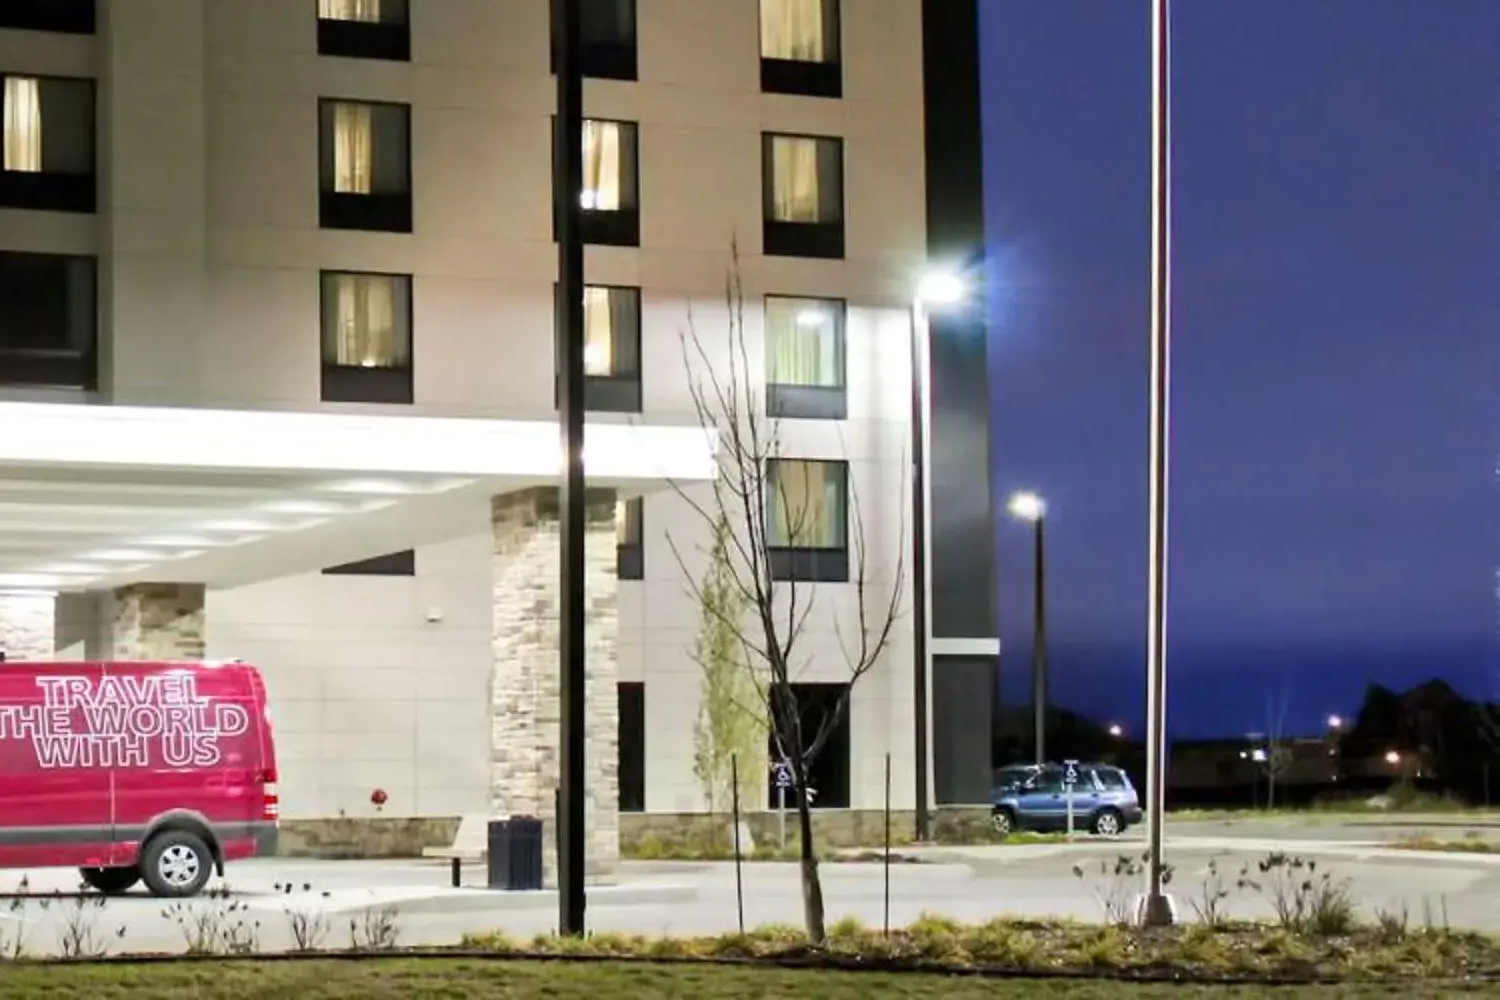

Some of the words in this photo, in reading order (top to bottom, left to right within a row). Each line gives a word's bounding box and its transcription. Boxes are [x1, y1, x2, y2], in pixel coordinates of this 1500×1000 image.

[36, 673, 209, 709] TRAVEL
[84, 703, 249, 737] WORLD
[33, 734, 149, 768] WITH
[162, 734, 221, 766] US
